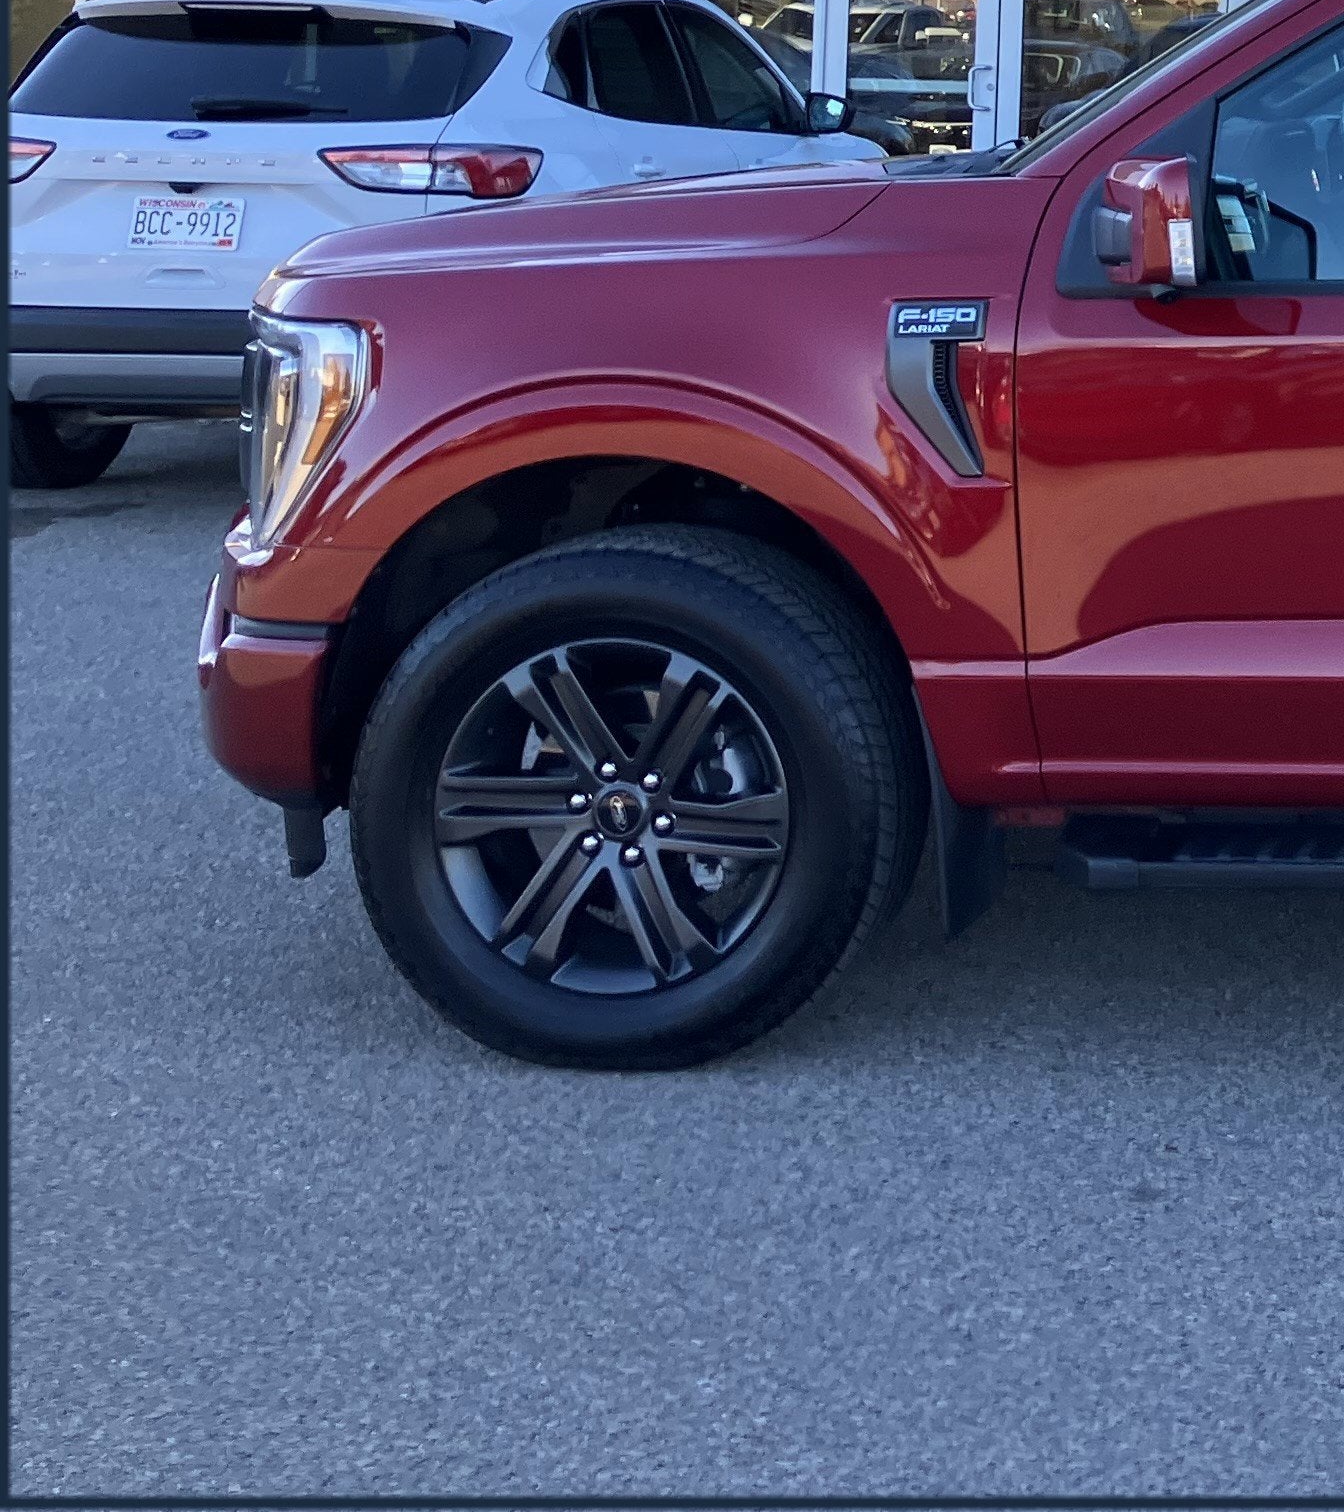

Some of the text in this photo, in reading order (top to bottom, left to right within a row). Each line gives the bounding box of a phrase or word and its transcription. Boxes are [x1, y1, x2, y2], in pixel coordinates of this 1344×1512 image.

[139, 198, 197, 208] WISCONSIN
[133, 210, 237, 237] BCC-9912
[897, 307, 978, 324] F-150
[897, 324, 951, 334] LARIAT
